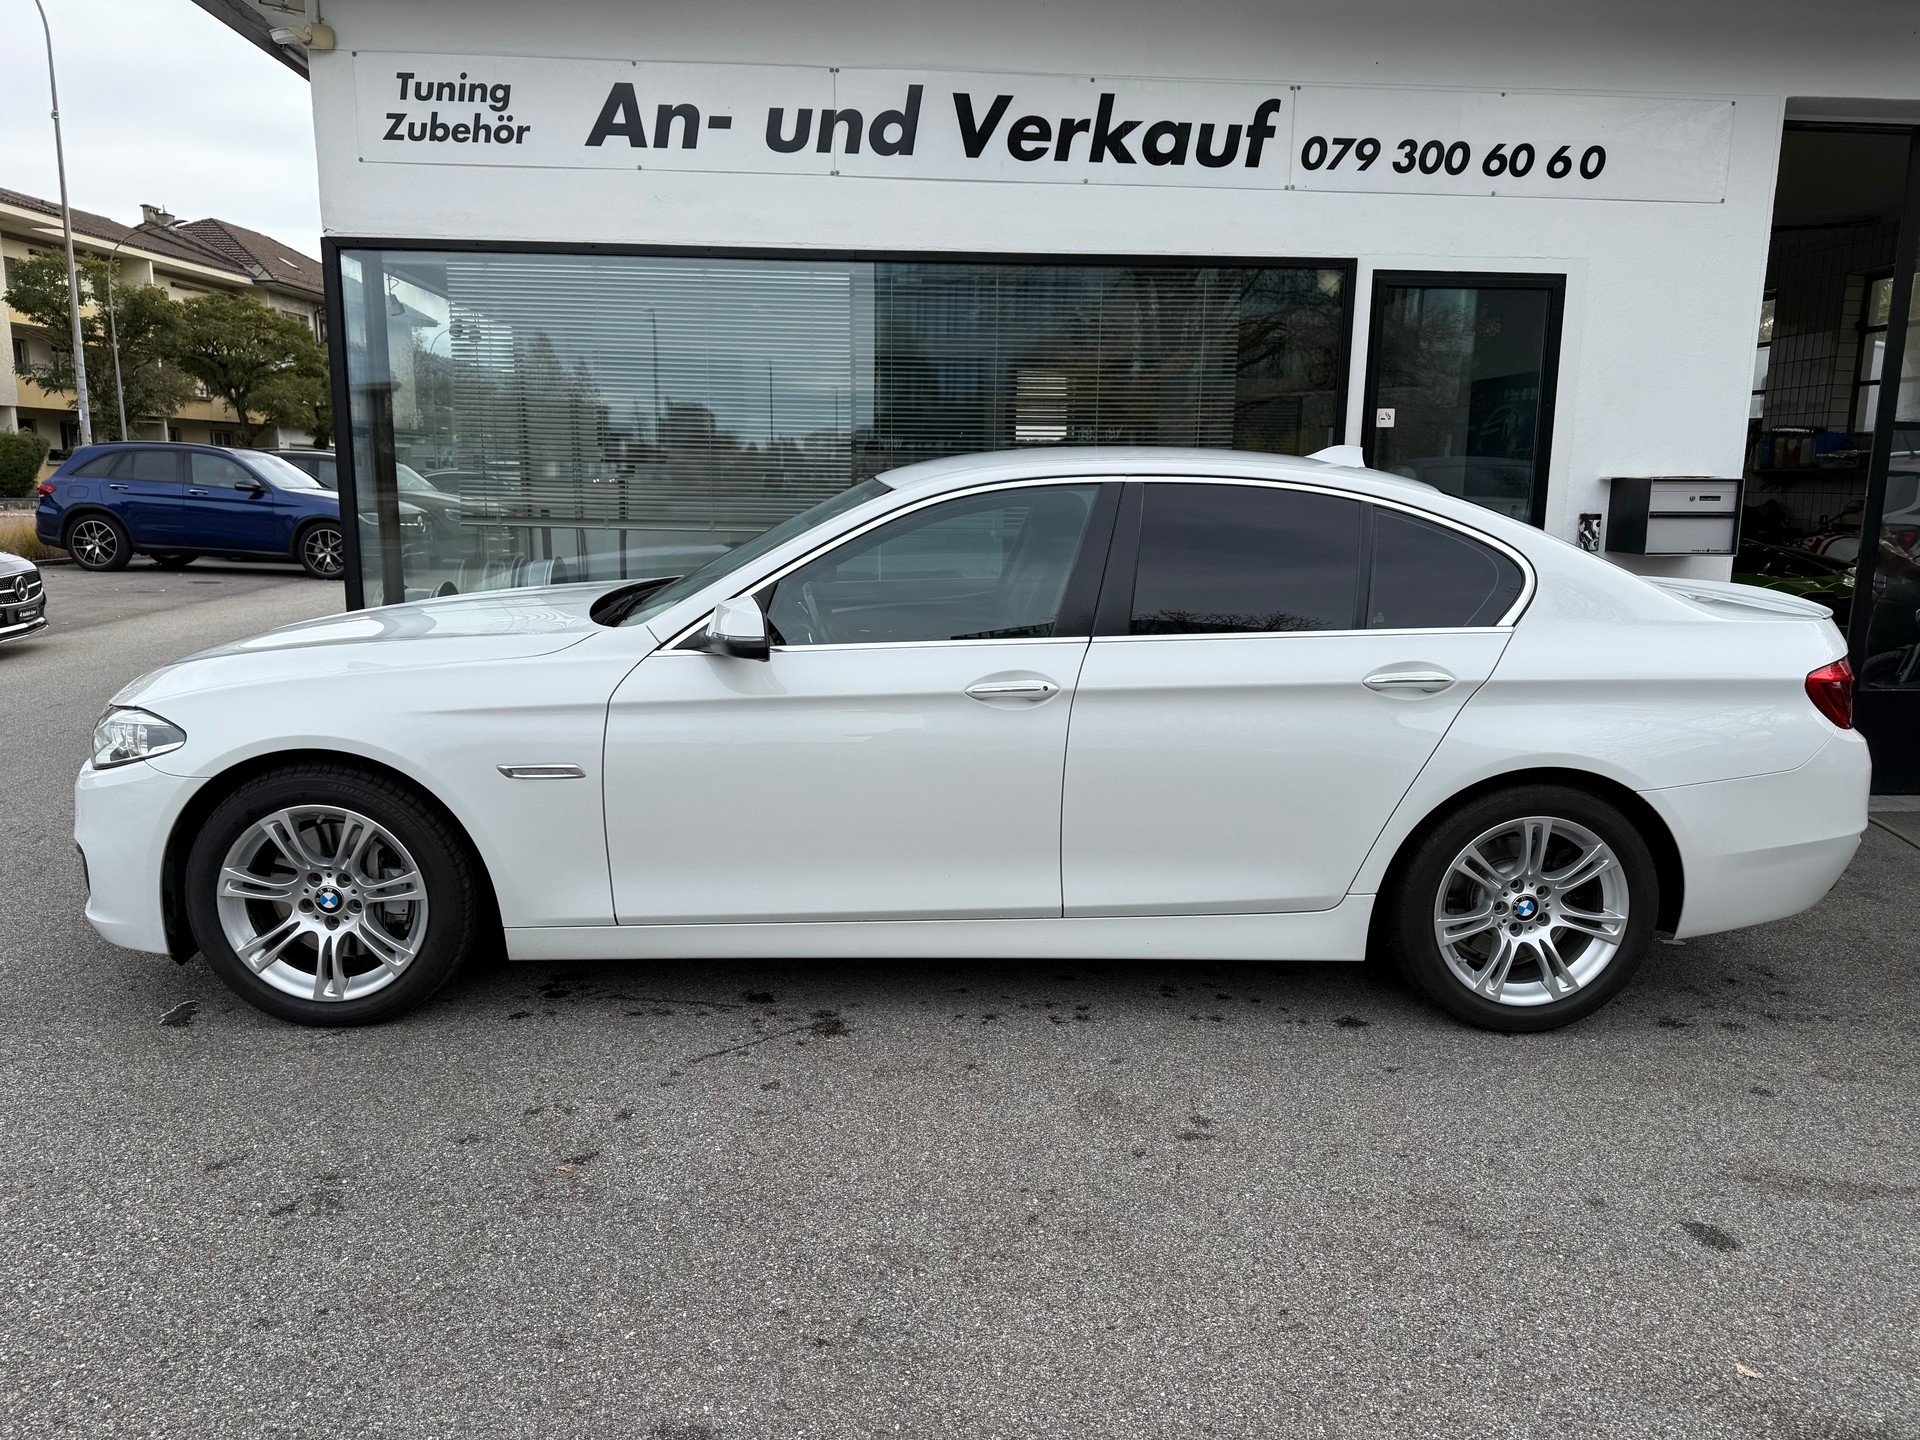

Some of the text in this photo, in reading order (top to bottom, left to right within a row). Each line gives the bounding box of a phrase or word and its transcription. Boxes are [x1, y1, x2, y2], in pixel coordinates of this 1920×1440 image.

[396, 72, 512, 113] Tuning
[382, 112, 531, 145] Zubehör
[584, 82, 1282, 169] An- und Verkauf
[1300, 135, 1607, 180] 079 300 60 60
